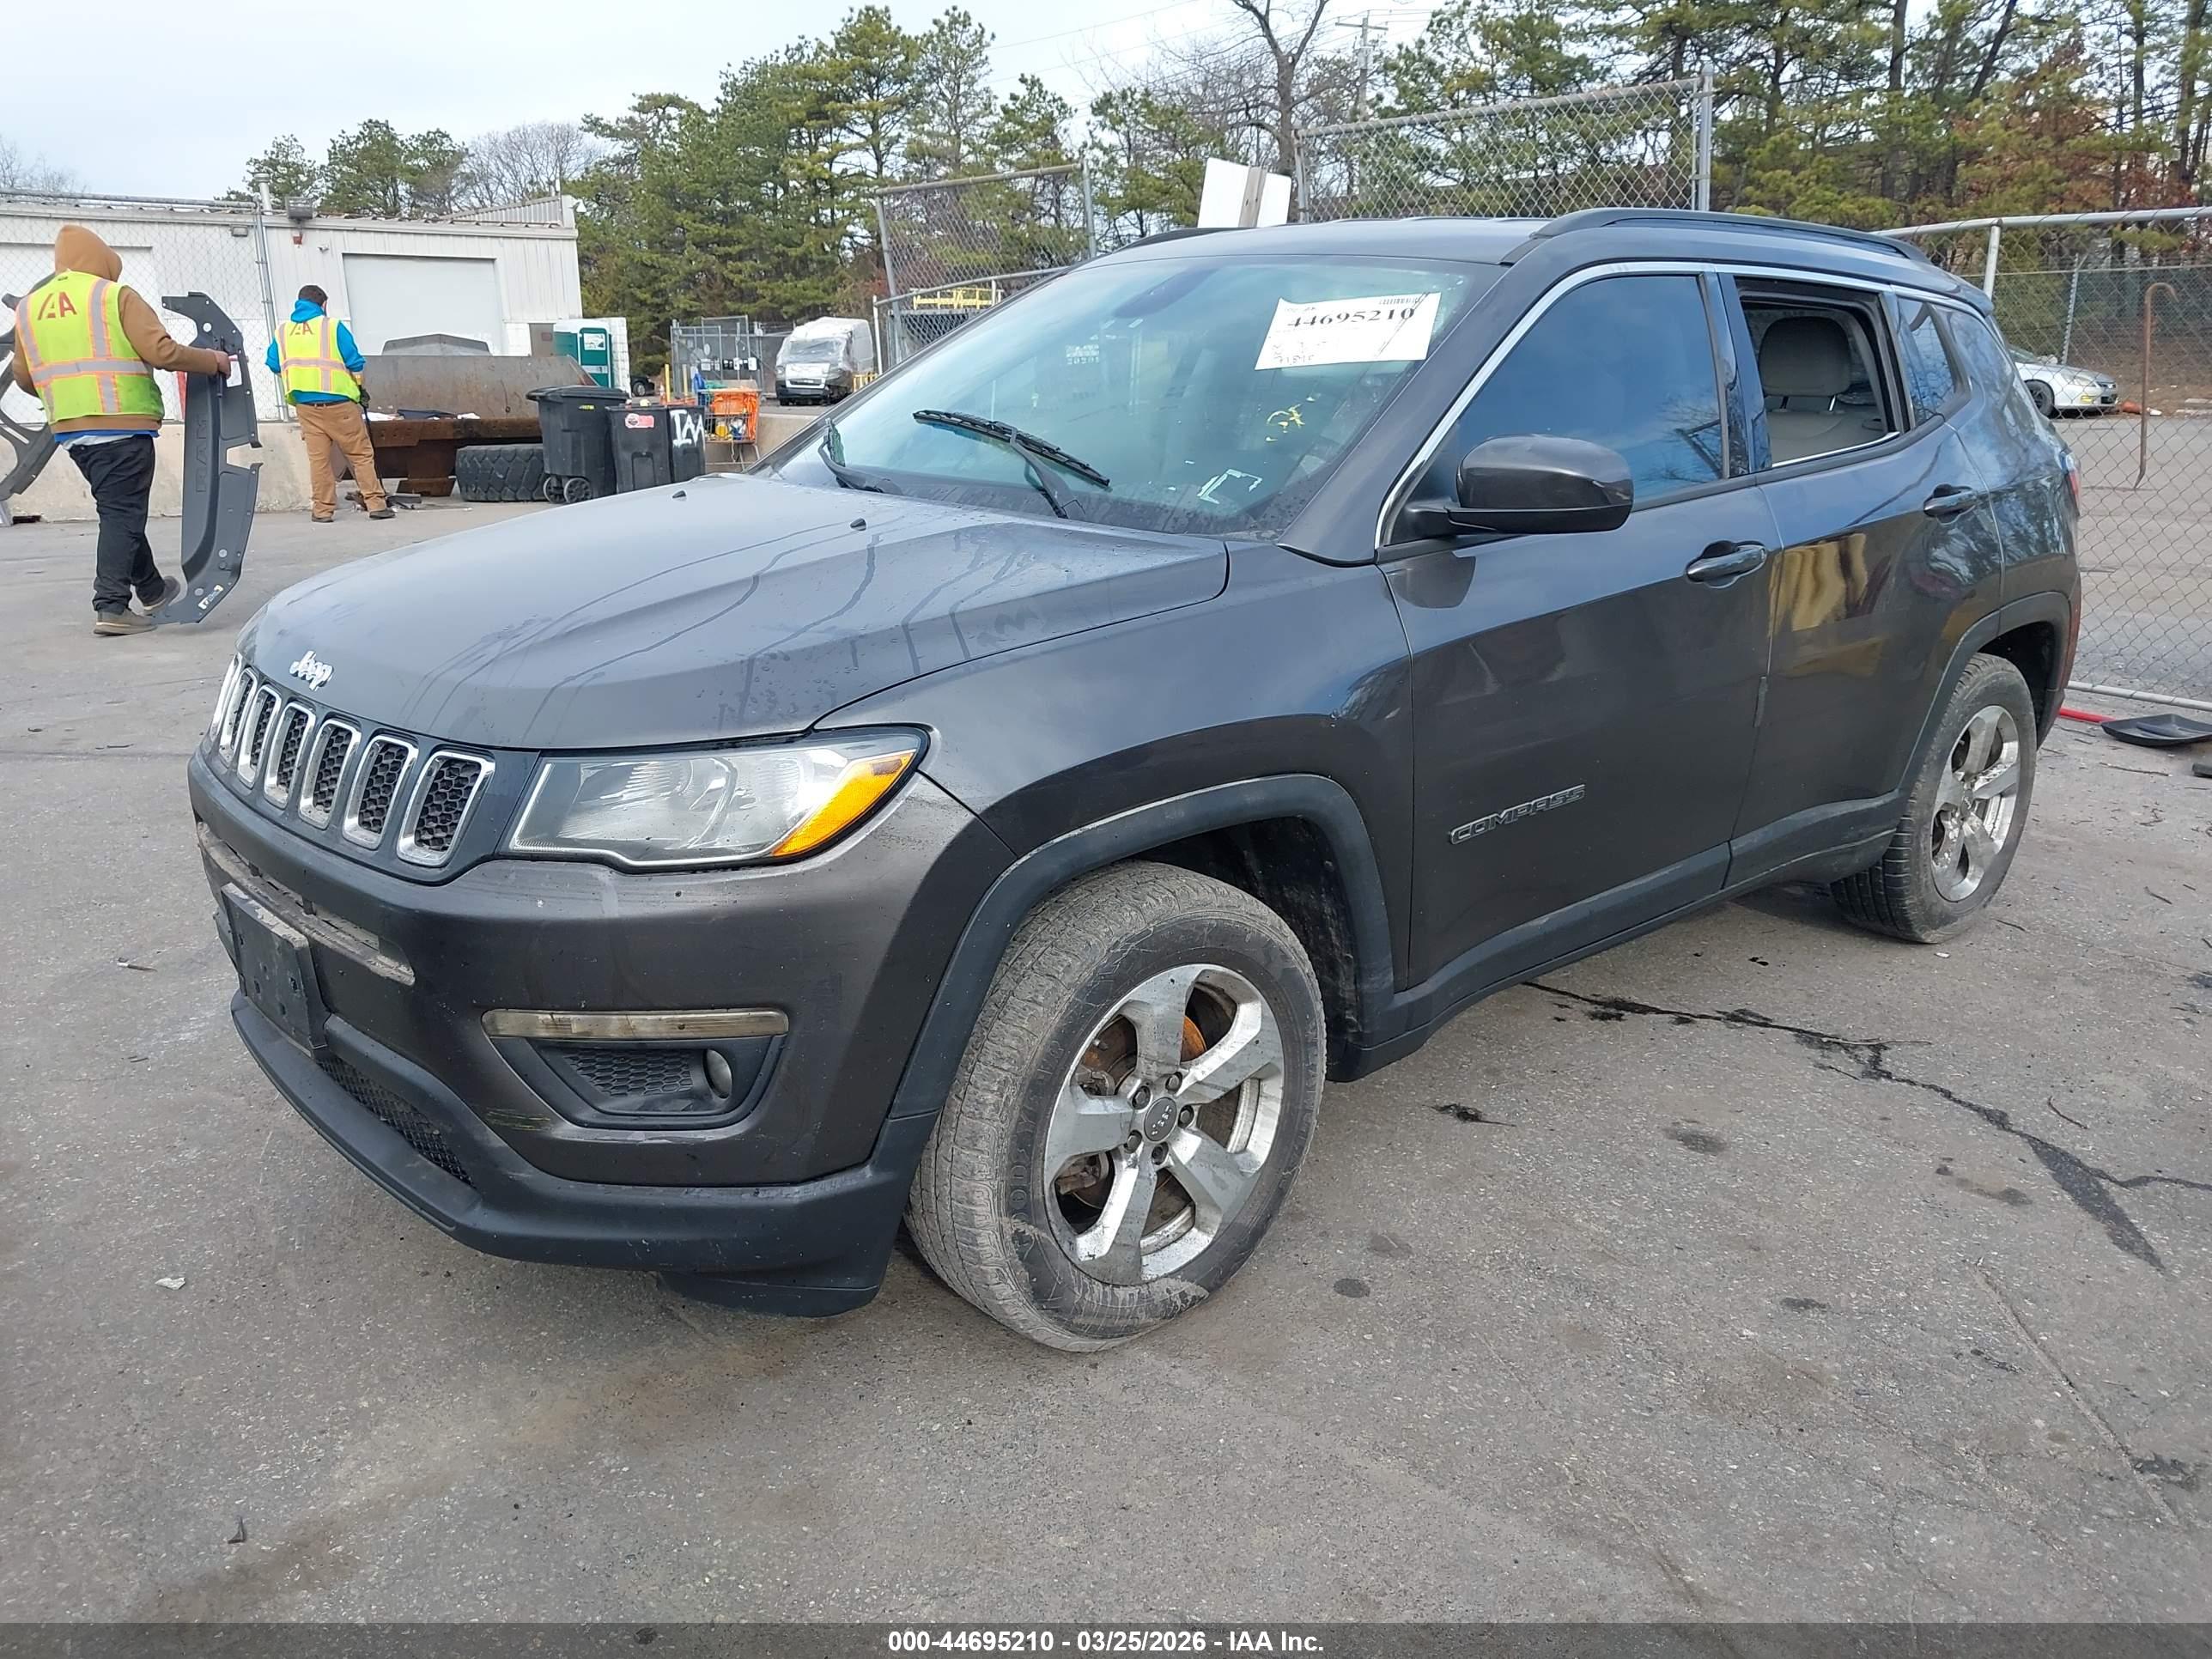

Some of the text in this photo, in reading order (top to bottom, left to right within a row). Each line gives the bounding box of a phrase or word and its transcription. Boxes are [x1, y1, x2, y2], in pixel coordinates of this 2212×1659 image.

[1286, 307, 1415, 328] 44695210
[289, 649, 334, 691] Jeep
[1449, 783, 1586, 845] COMPASS
